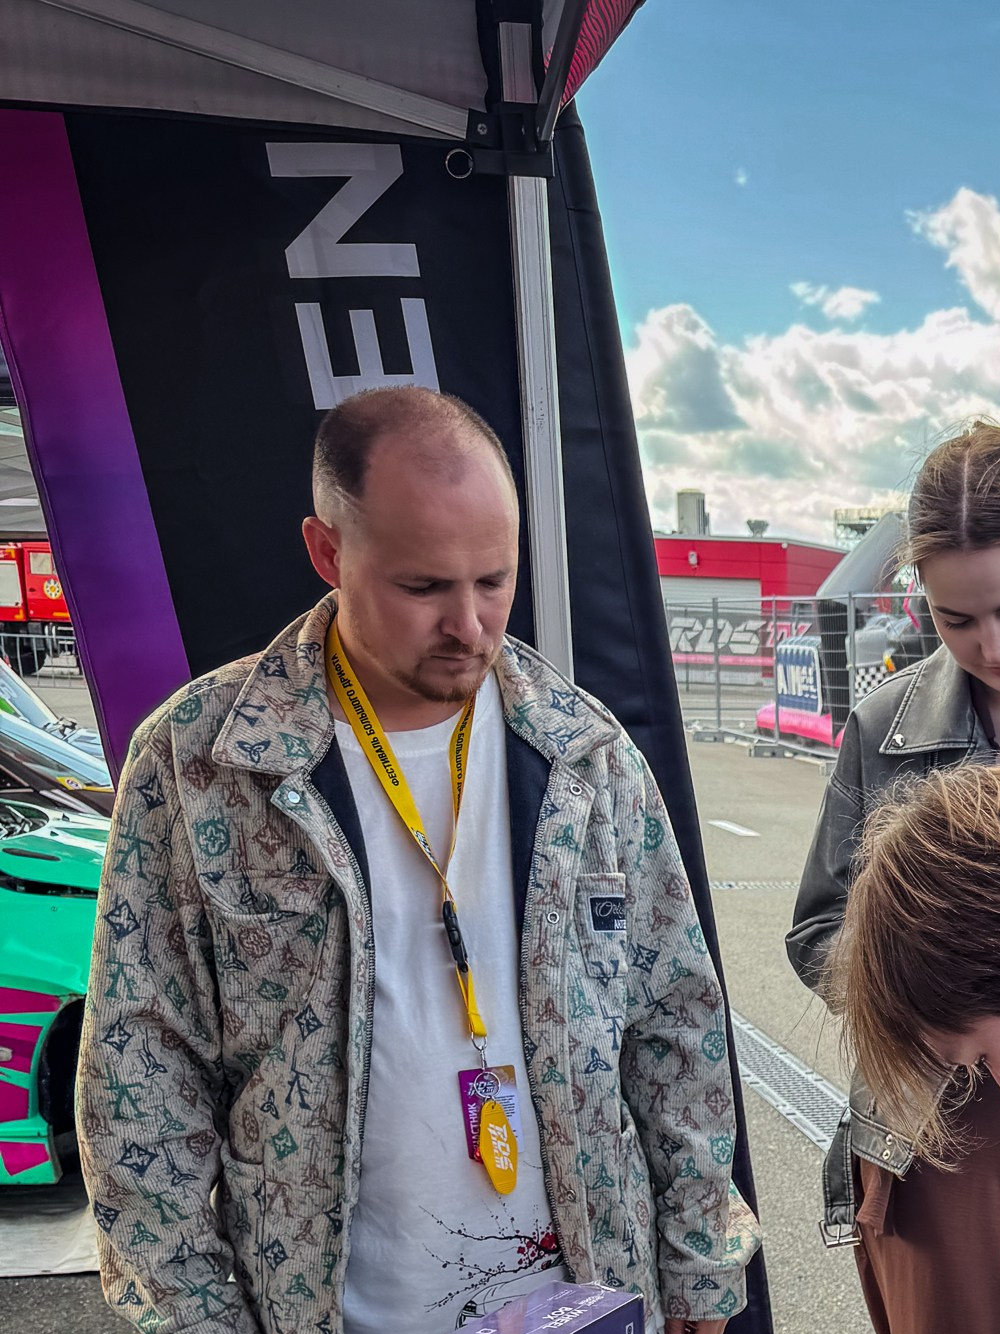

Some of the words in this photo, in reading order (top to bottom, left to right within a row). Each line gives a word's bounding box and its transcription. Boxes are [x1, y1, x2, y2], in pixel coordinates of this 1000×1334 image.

[331, 653, 352, 689] ДРИФТА
[349, 688, 376, 735] БОЛЬШОГО
[370, 734, 399, 787] ФЕСТИВАЛЬ
